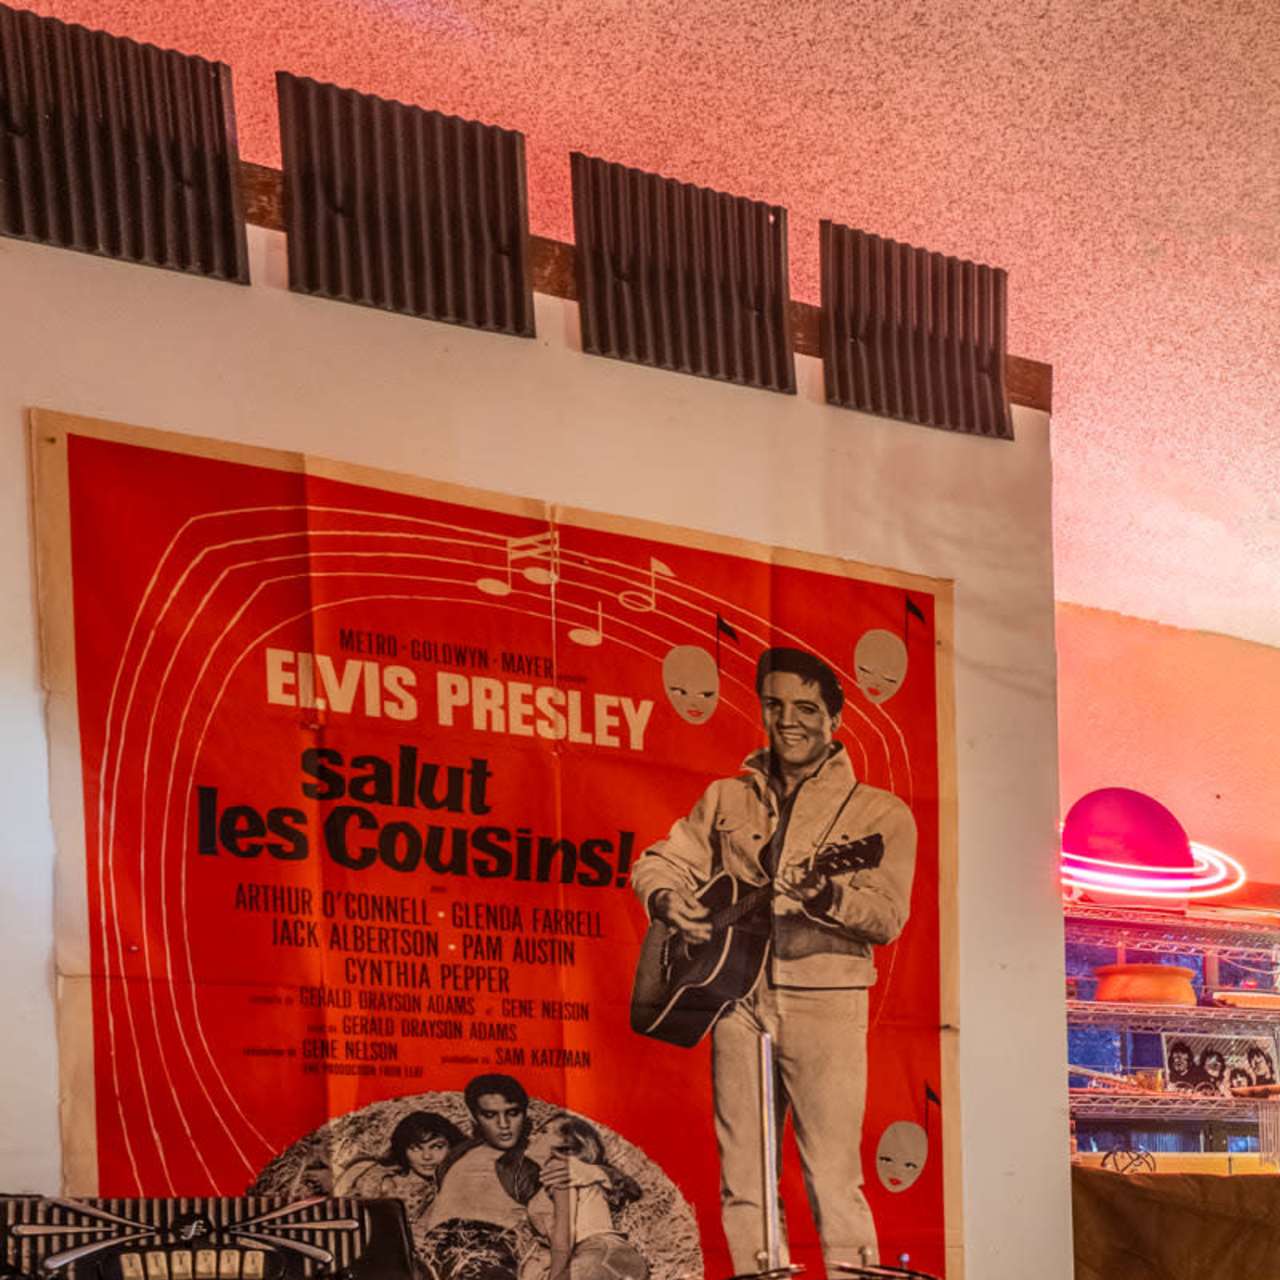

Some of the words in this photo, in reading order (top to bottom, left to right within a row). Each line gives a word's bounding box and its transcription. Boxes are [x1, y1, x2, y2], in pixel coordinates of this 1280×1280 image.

[338, 628, 397, 658] METRO
[410, 633, 489, 670] GOLDWYN
[501, 651, 554, 680] MAYER
[265, 648, 418, 722] ELVIS
[437, 671, 655, 751] PRESLEY
[301, 744, 493, 816] salut
[195, 785, 309, 861] les
[323, 805, 636, 889] Cousins!
[234, 883, 314, 914] ARTHUR
[321, 889, 432, 926] O'CONNELL
[451, 901, 524, 933] GLENDA
[531, 907, 605, 937] FARRELL
[271, 918, 321, 949] JACK
[329, 923, 440, 958] ALBERTSON
[461, 932, 503, 962] PAM
[512, 937, 576, 967] AUSTIN
[344, 957, 431, 990] CYNTHIA
[440, 963, 510, 993] PEPPER
[301, 985, 351, 1010] GERALD
[358, 990, 422, 1014] DRAYSON
[426, 995, 476, 1017] ADAMS
[501, 997, 535, 1019] GENE
[541, 1000, 591, 1023] NELSON
[301, 1038, 345, 1061] GENE
[348, 1040, 399, 1062] NELSON
[342, 1016, 395, 1038] GERALD
[401, 1018, 464, 1041] DRAYSON
[468, 1021, 518, 1042] ADAMS
[495, 1047, 526, 1067] SAM
[531, 1048, 592, 1069] KATZMAN
